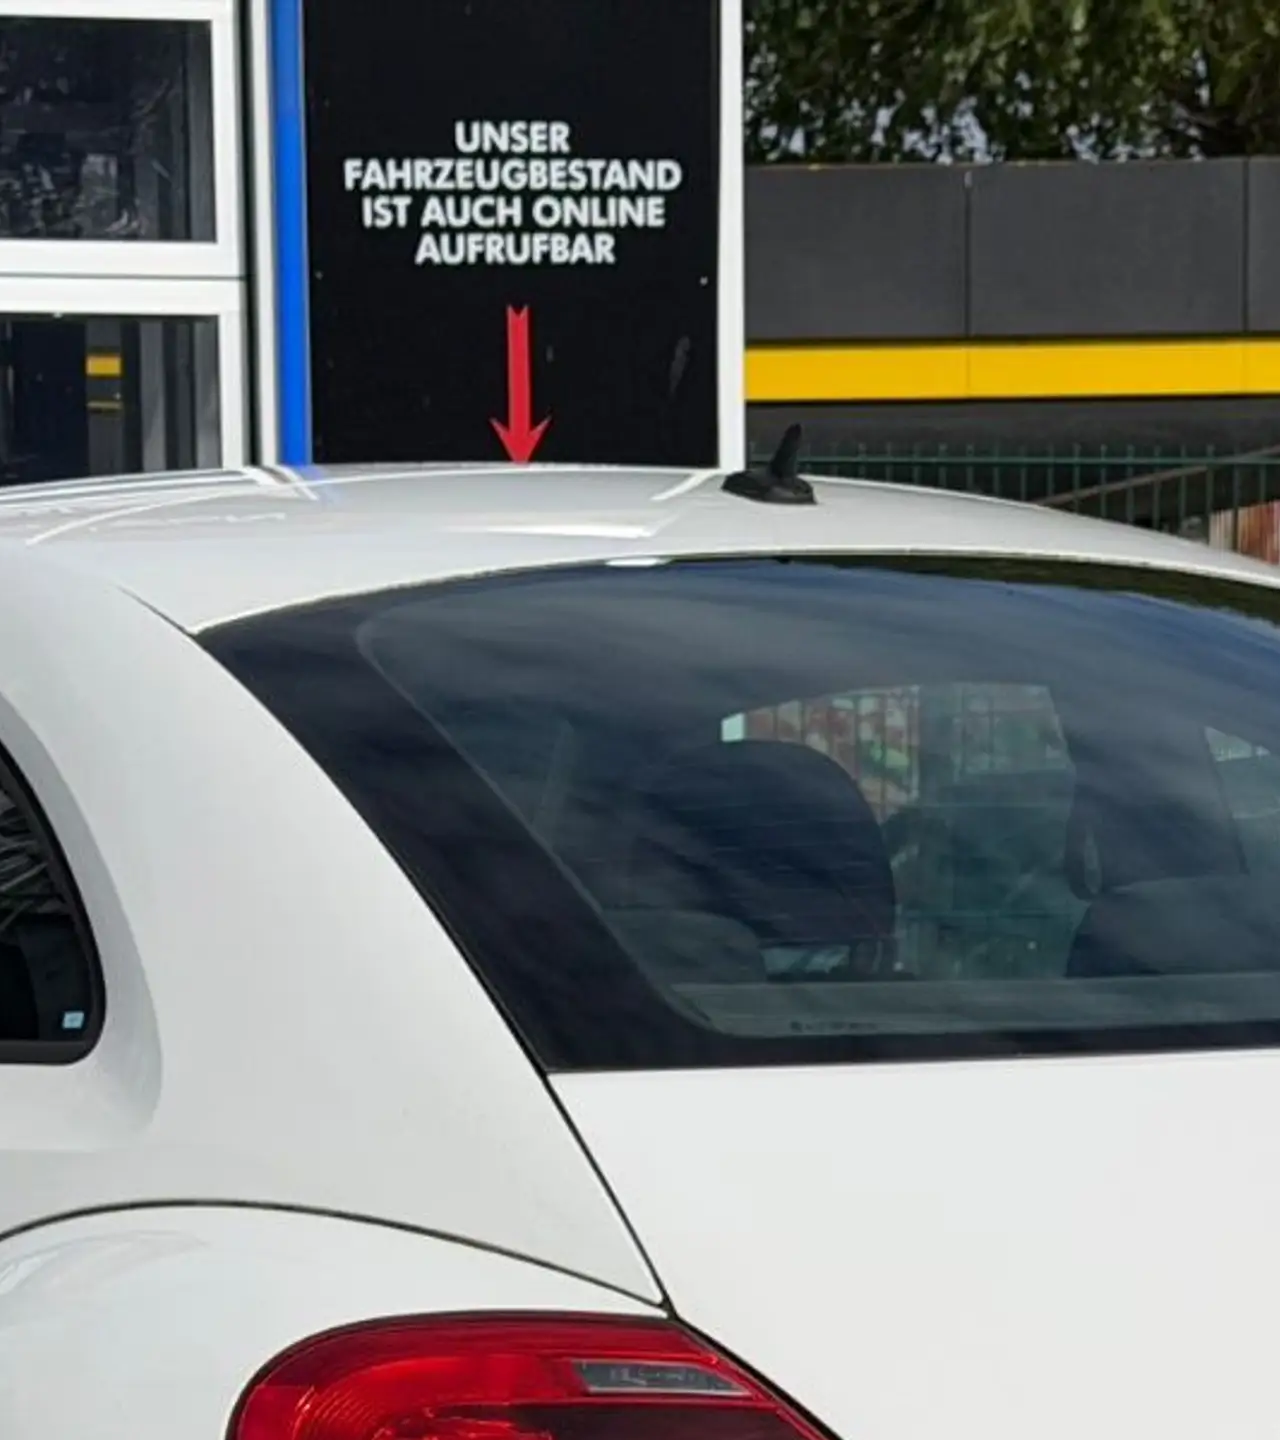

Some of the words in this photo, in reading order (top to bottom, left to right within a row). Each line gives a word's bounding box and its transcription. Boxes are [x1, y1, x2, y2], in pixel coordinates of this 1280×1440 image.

[454, 121, 571, 153] UNSER
[344, 159, 682, 191] FAHRZEUGBESTAND
[362, 196, 412, 228] IST
[421, 196, 523, 228] AUCH
[532, 196, 666, 228] ONLINE
[415, 233, 616, 264] AUFRUFBAR
